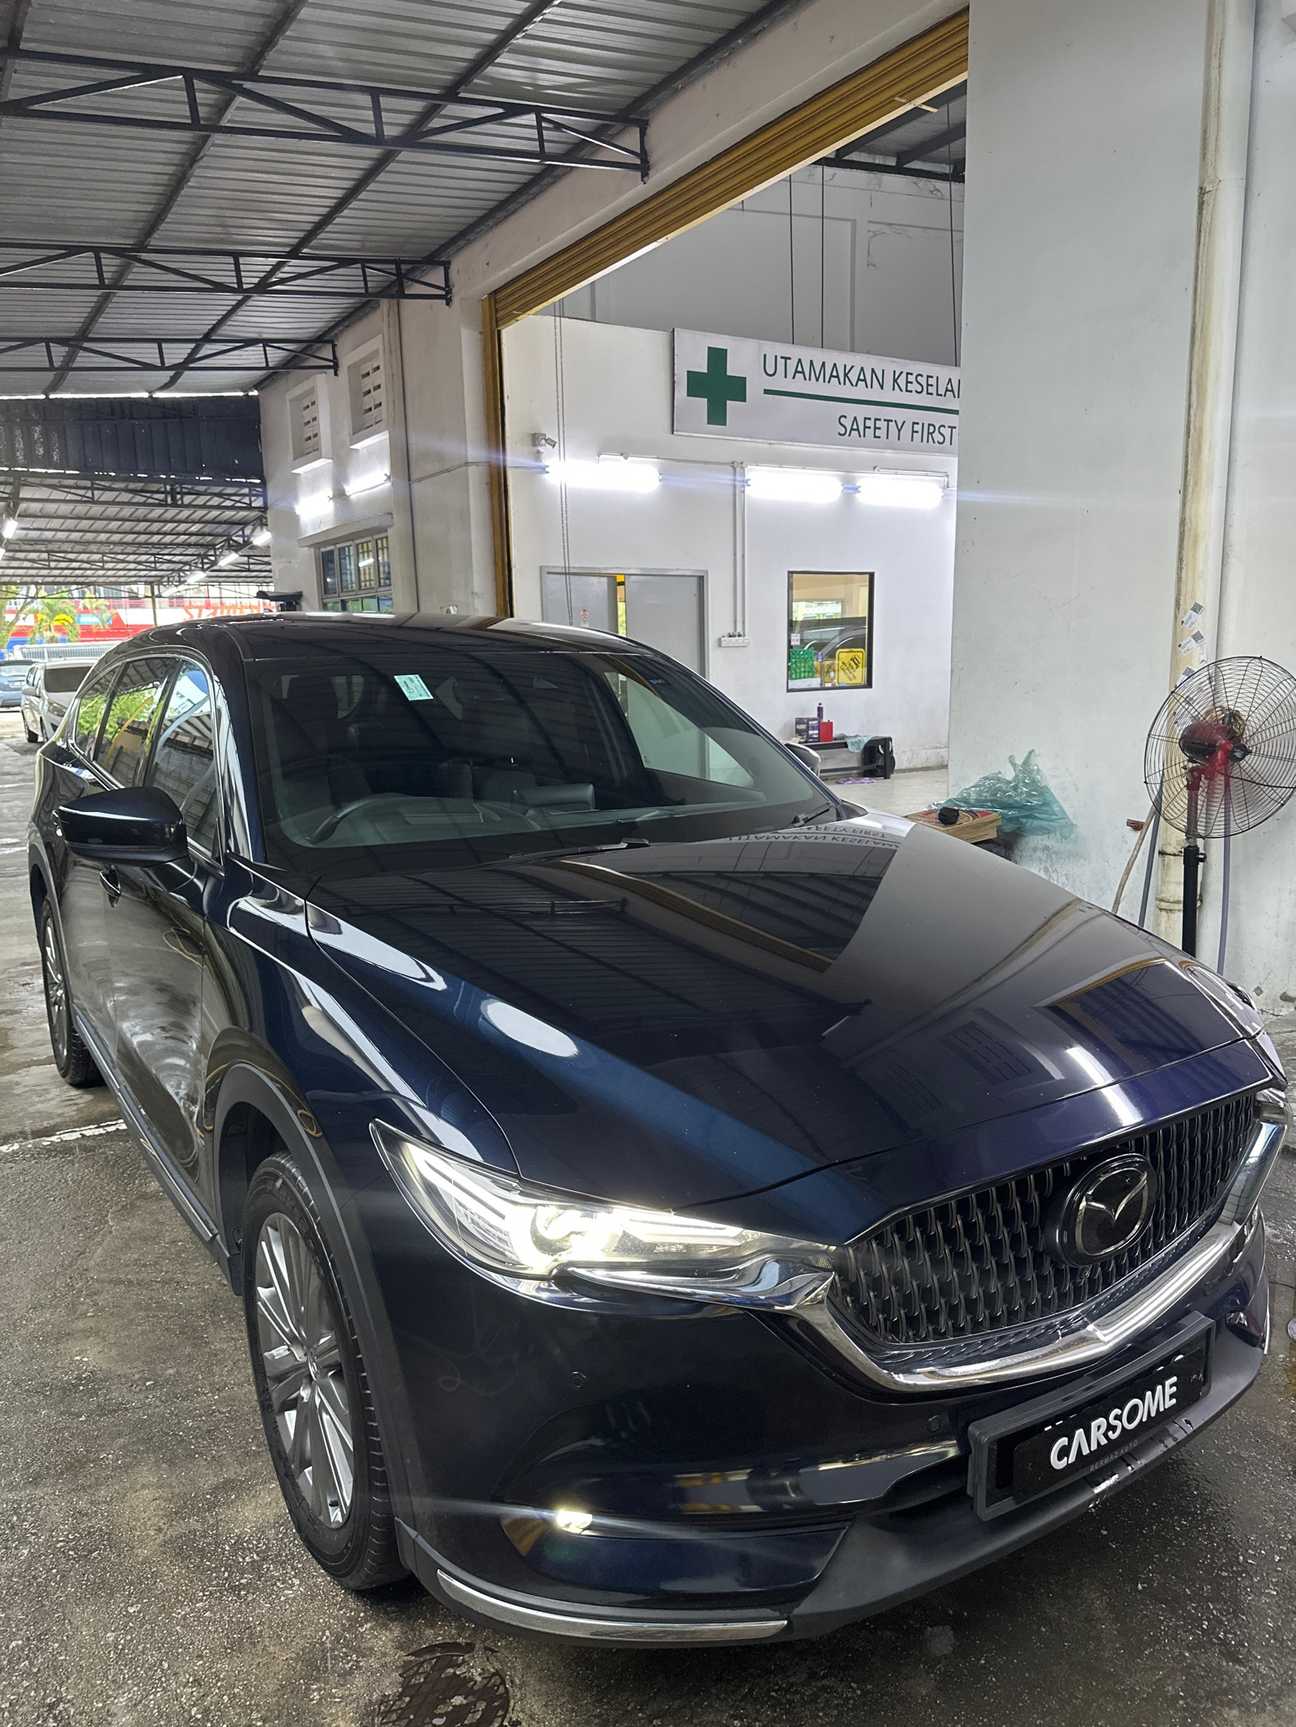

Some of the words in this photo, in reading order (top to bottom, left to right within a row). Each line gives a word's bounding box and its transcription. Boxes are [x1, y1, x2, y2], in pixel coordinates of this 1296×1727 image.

[763, 353, 885, 391] UTAMAKAN
[891, 370, 961, 400] KESELA
[837, 414, 906, 442] SAFETY
[910, 421, 957, 446] FIRST
[1050, 1376, 1178, 1471] CARSOME
